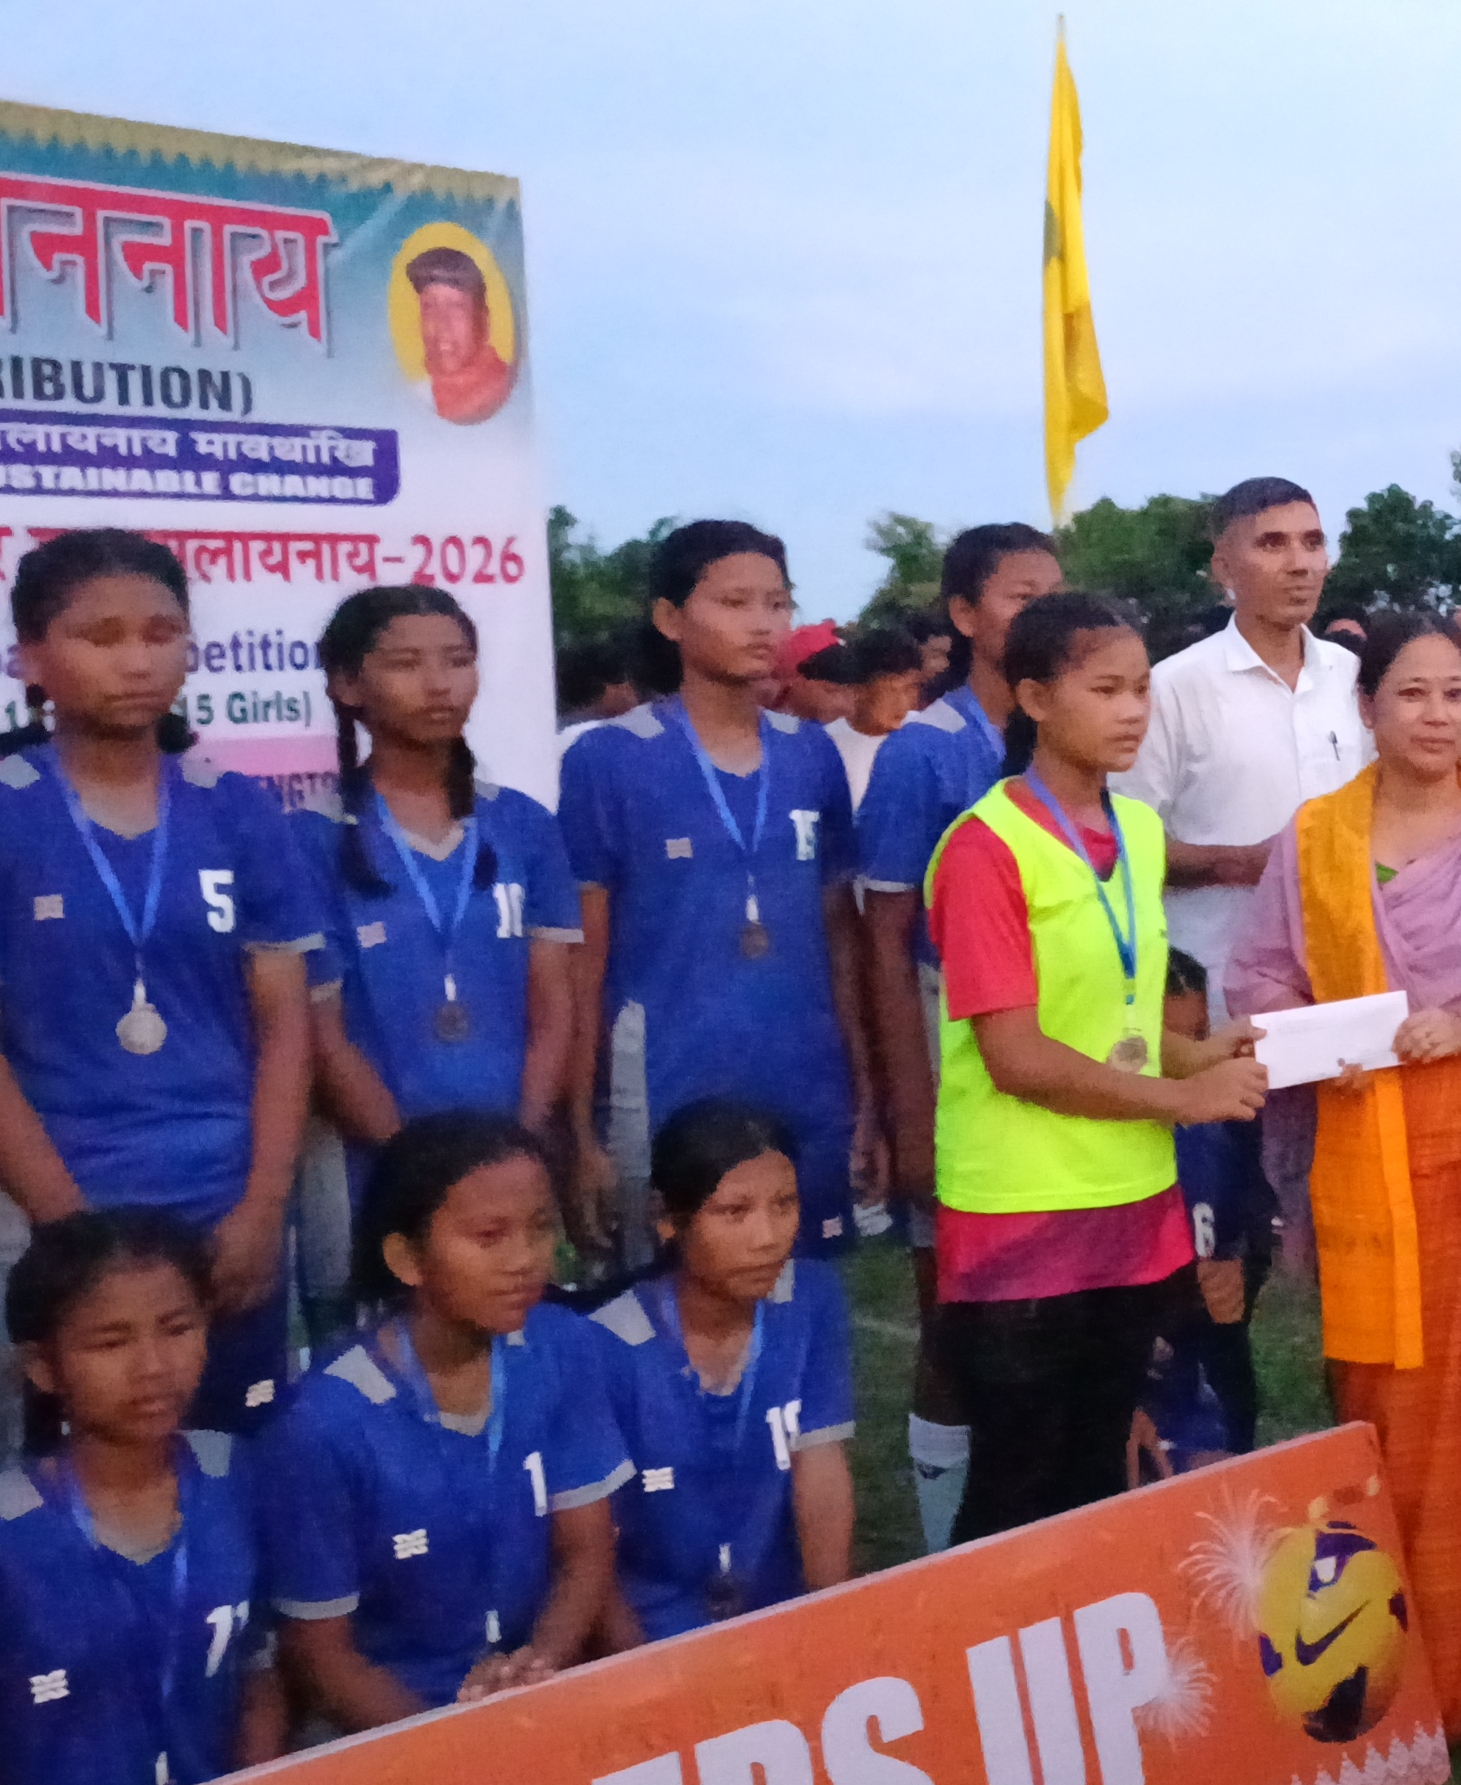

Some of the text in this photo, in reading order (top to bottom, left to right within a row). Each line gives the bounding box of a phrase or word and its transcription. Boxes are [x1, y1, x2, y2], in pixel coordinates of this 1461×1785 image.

[0, 173, 338, 345] ननाय
[0, 355, 253, 416] IBUTION)
[0, 422, 179, 459] लायनाय
[0, 463, 376, 500] STAINABLE CHANGE
[226, 690, 312, 728] Girls)
[199, 869, 235, 933] 5
